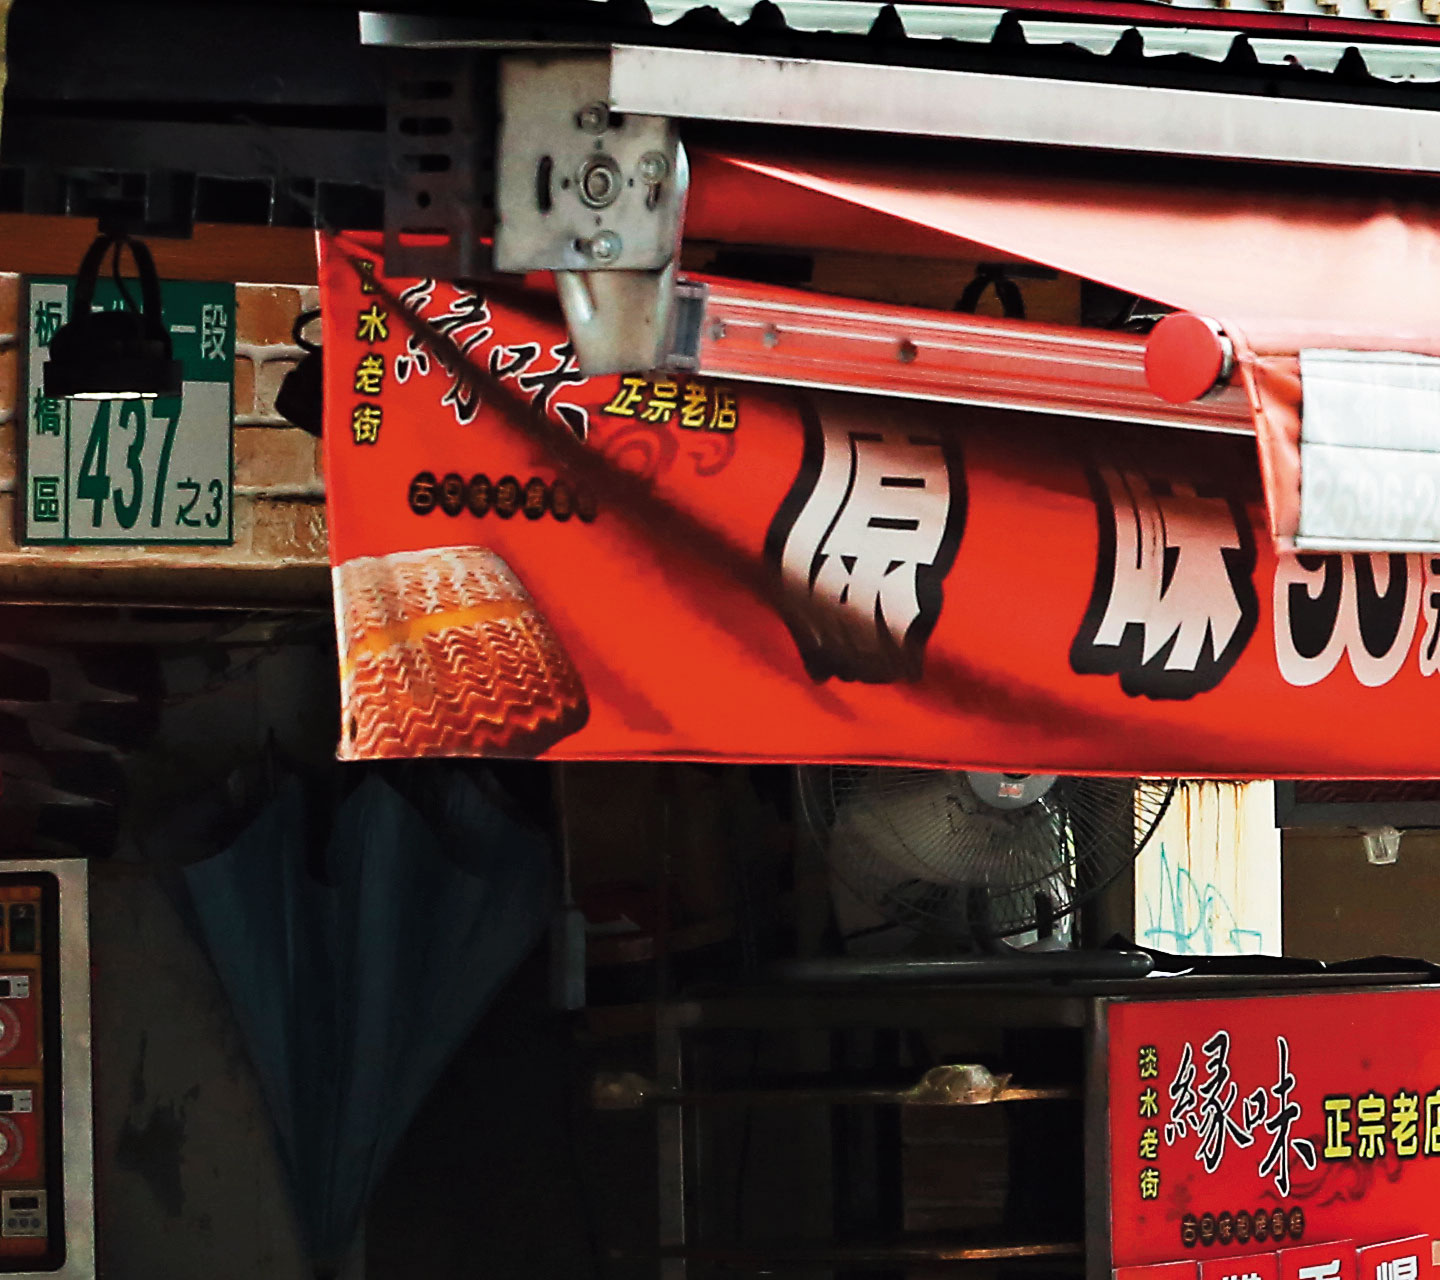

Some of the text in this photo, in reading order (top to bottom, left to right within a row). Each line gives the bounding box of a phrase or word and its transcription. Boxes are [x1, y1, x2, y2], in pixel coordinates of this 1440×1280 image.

[77, 399, 182, 528] 437
[605, 376, 739, 430] 正宗老店
[1138, 1046, 1159, 1200] 淡水老街
